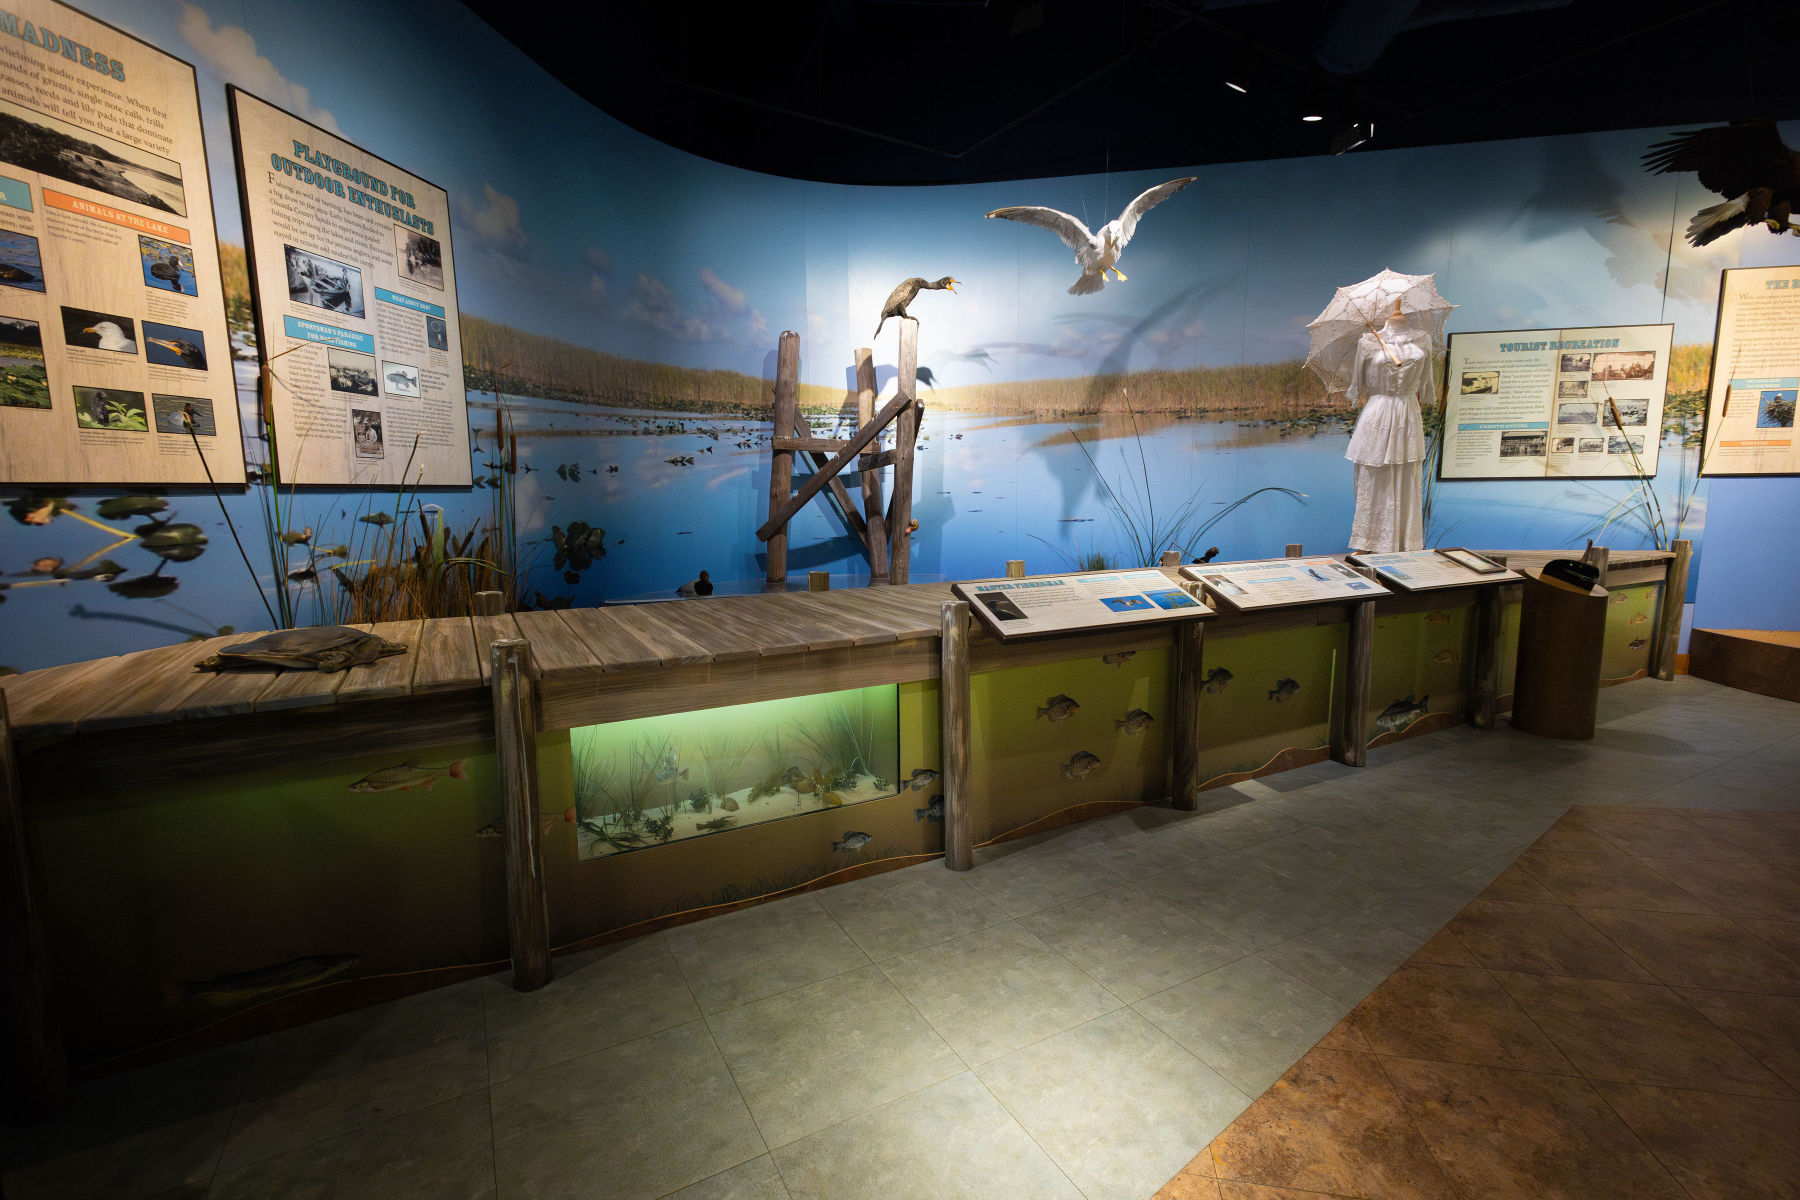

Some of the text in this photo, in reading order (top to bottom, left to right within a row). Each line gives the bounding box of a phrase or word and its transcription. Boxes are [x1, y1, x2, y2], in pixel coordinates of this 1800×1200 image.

[0, 9, 125, 82] MADNESS
[1, 86, 40, 106] animals
[42, 102, 59, 114] will
[62, 108, 76, 120] tell
[78, 115, 95, 127] you
[97, 120, 113, 133] that
[122, 130, 142, 145] large
[143, 140, 170, 156] variety
[30, 71, 41, 81] of
[42, 76, 75, 95] grunts,
[77, 90, 102, 105] single
[104, 100, 123, 113] note
[124, 109, 144, 122] calls,
[146, 116, 165, 130] trills
[35, 86, 60, 101] reeds
[62, 97, 79, 109] and
[81, 102, 95, 116] lily
[97, 110, 117, 123] pads
[119, 117, 135, 130] that
[137, 125, 174, 145] dominate
[48, 65, 74, 81] audio
[76, 77, 124, 101] experience.
[126, 95, 150, 112] When
[152, 106, 167, 119] first
[271, 153, 435, 236] OUTDOOR ENTHUSIASTS
[292, 139, 416, 209] PLAYGROUND FOR
[72, 200, 169, 234] ANIMALS AT THE LAKE
[1765, 280, 1790, 290] THE
[1499, 338, 1620, 352] TOURIST RECREATION
